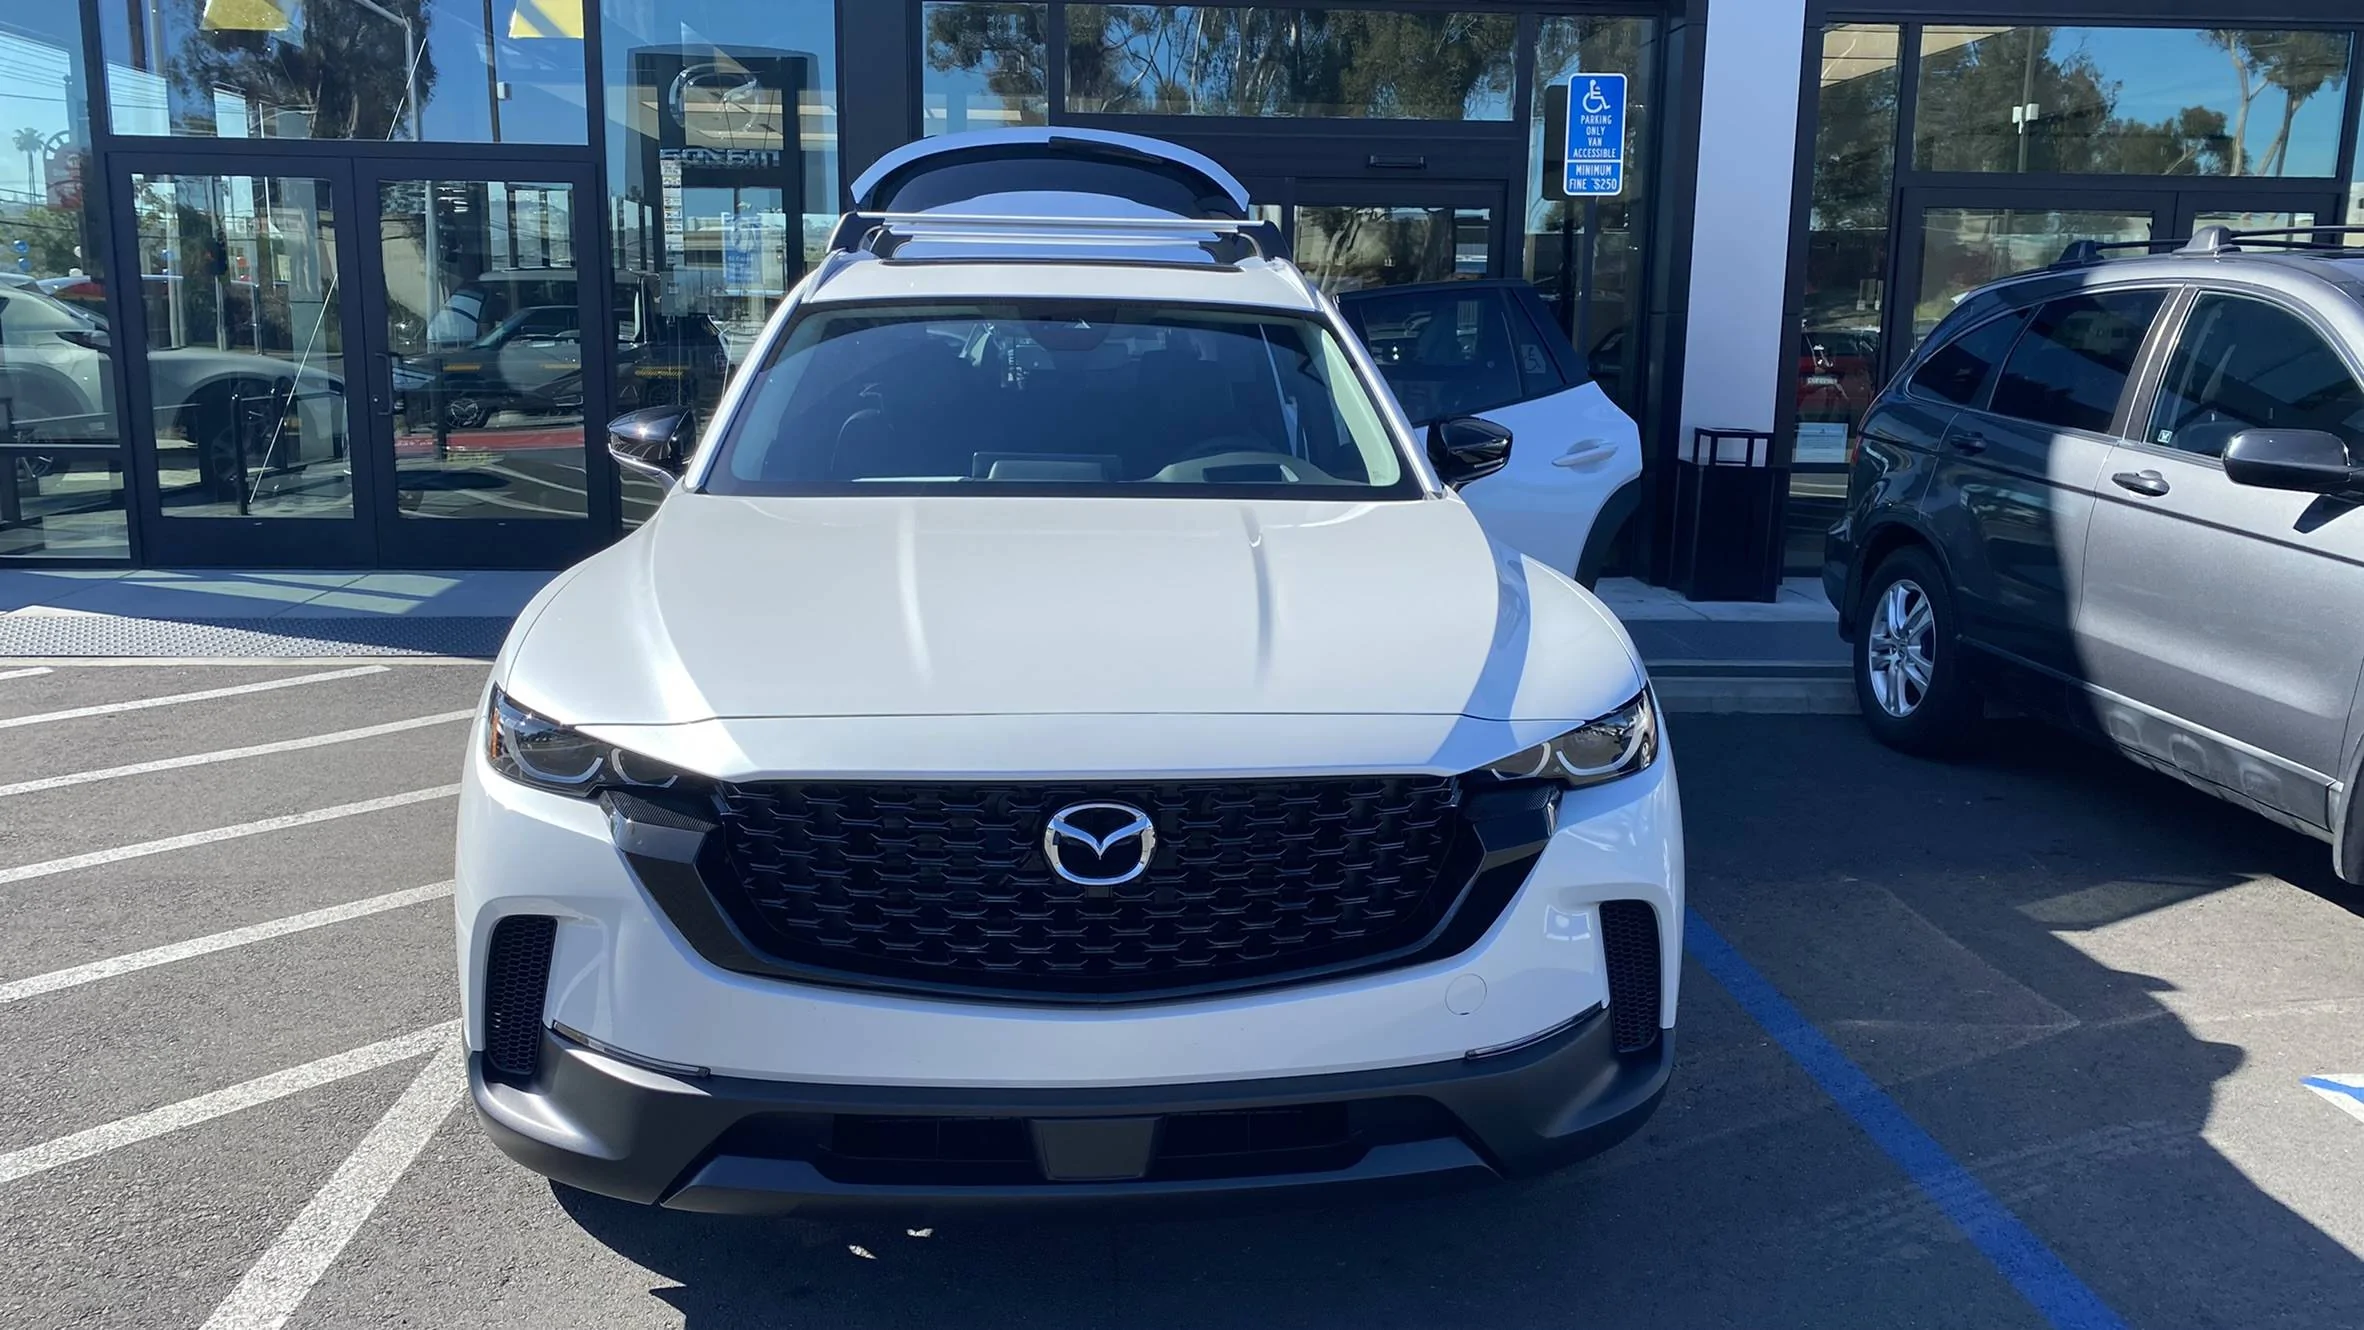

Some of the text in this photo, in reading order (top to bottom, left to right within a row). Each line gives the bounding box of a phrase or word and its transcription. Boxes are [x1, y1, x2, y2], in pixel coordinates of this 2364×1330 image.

[1580, 114, 1612, 125] PARKING
[1586, 126, 1605, 136] ONLY
[1588, 137, 1602, 147] VAN
[1573, 148, 1616, 158] ACCESSIBLE
[1575, 164, 1612, 176] MINIMUM
[1569, 178, 1617, 191] FINE $250
